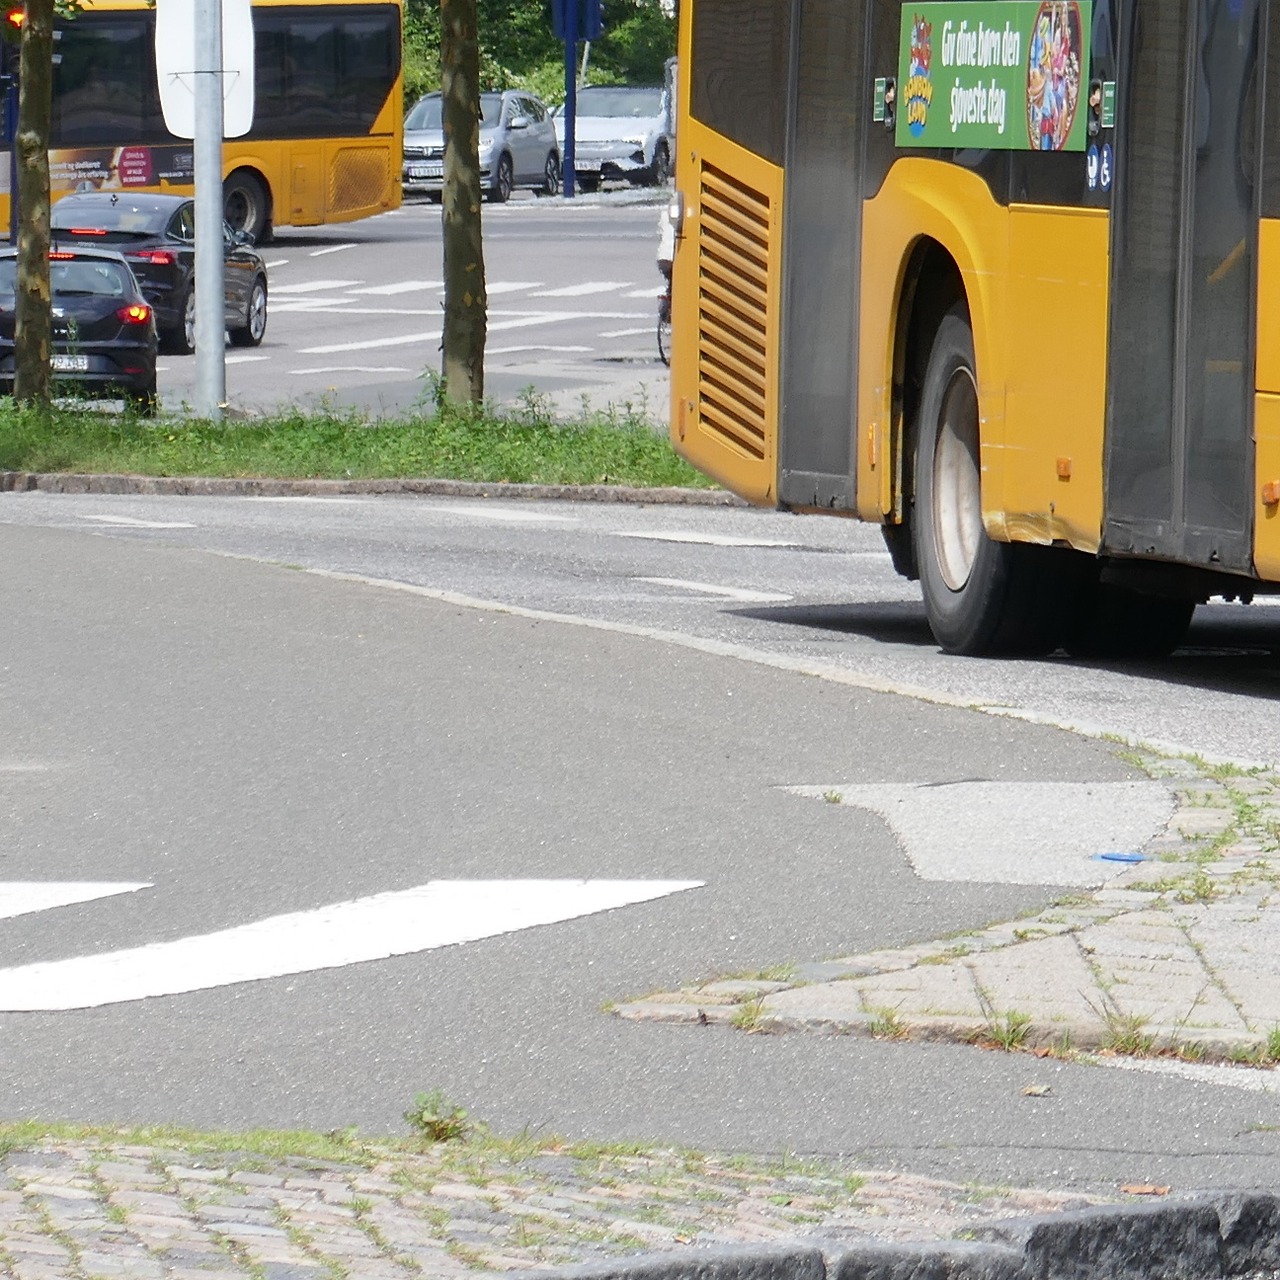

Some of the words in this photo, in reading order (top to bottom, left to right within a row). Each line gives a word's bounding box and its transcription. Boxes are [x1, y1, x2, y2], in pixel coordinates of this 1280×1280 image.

[941, 20, 956, 67] Giv
[956, 20, 977, 67] dine
[977, 21, 1001, 69] børn
[1002, 21, 1020, 67] den
[949, 77, 987, 133] sjoveste
[987, 78, 1006, 134] dag
